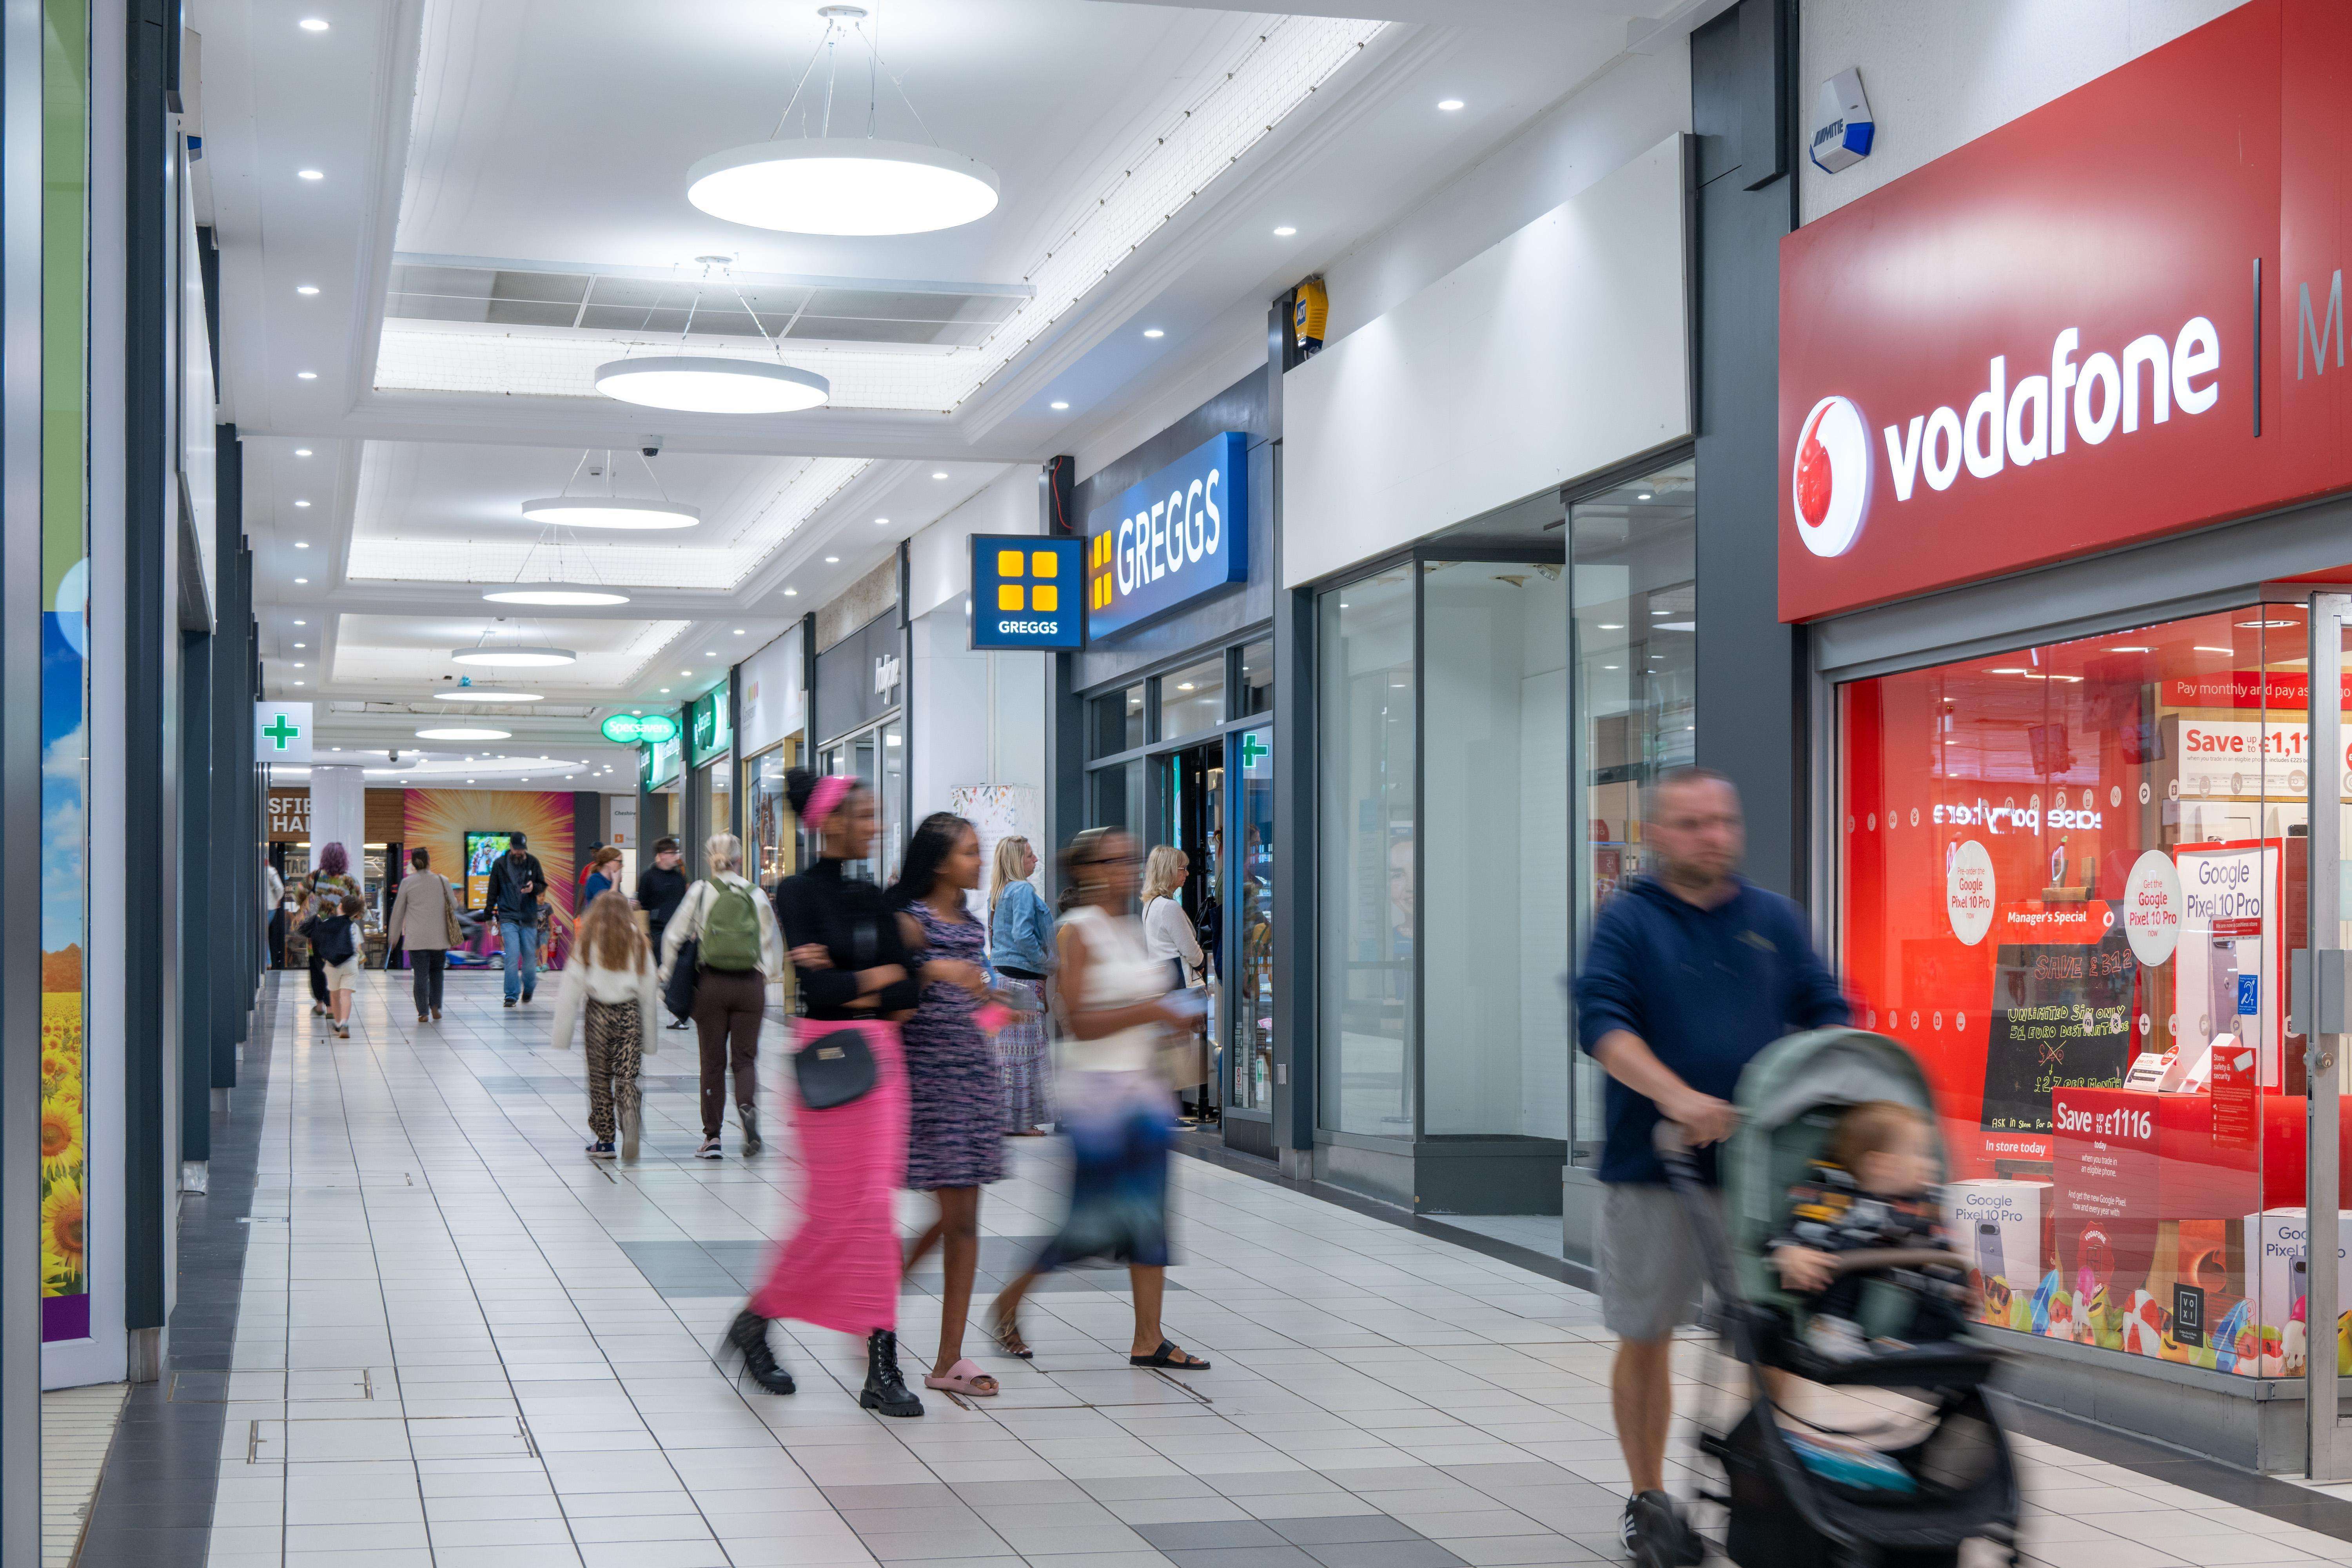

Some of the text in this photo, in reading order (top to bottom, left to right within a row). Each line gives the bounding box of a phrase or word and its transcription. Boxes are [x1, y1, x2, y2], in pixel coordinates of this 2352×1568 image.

[1297, 303, 1306, 322] ADT
[1884, 317, 2219, 501] vodafone
[1117, 468, 1220, 596] GREGGS
[998, 621, 1058, 634] GREGGS
[2178, 682, 2196, 696] Pay
[2200, 684, 2247, 697] monthly
[2275, 686, 2294, 699] pay
[610, 721, 670, 734] Specsavers
[2186, 729, 2243, 752] Save
[2247, 735, 2257, 744] up
[1957, 867, 1976, 875] Pre-order
[2199, 859, 2249, 890] Google
[1960, 878, 1982, 893] Google
[2143, 880, 2162, 889] Get the
[1952, 895, 1990, 908] Pixel 10 Pro
[2138, 891, 2167, 909] Google
[2187, 892, 2260, 917] Pixel 10 Pro
[2007, 911, 2086, 926] Manager's Special
[2130, 911, 2176, 926] Pixel 10 Pro
[2034, 955, 2082, 980] SAVE
[2010, 1025, 2025, 1040] 51
[2028, 1026, 2056, 1039] EURO
[2214, 1063, 2226, 1072] safety
[2213, 1073, 2230, 1081] security
[2057, 1102, 2151, 1139] Save up to £1116
[1986, 1140, 2045, 1156] In store today
[2094, 1140, 2106, 1151] today
[2082, 1154, 2092, 1162] when
[2102, 1157, 2112, 1165] trade
[2113, 1157, 2117, 1165] in
[2087, 1166, 2101, 1176] eligible
[2102, 1167, 2116, 1176] phone.
[1967, 1194, 2012, 1209] Google
[2100, 1194, 2114, 1206] Google
[2115, 1197, 2126, 1207] Pixel
[1956, 1209, 2022, 1221] Pixel 10 Pro
[2089, 1205, 2100, 1215] every
[2100, 1207, 2110, 1215] year
[2110, 1207, 2120, 1217] with
[2085, 1230, 2106, 1244] VODAFONE
[2267, 1244, 2298, 1256] Pixel
